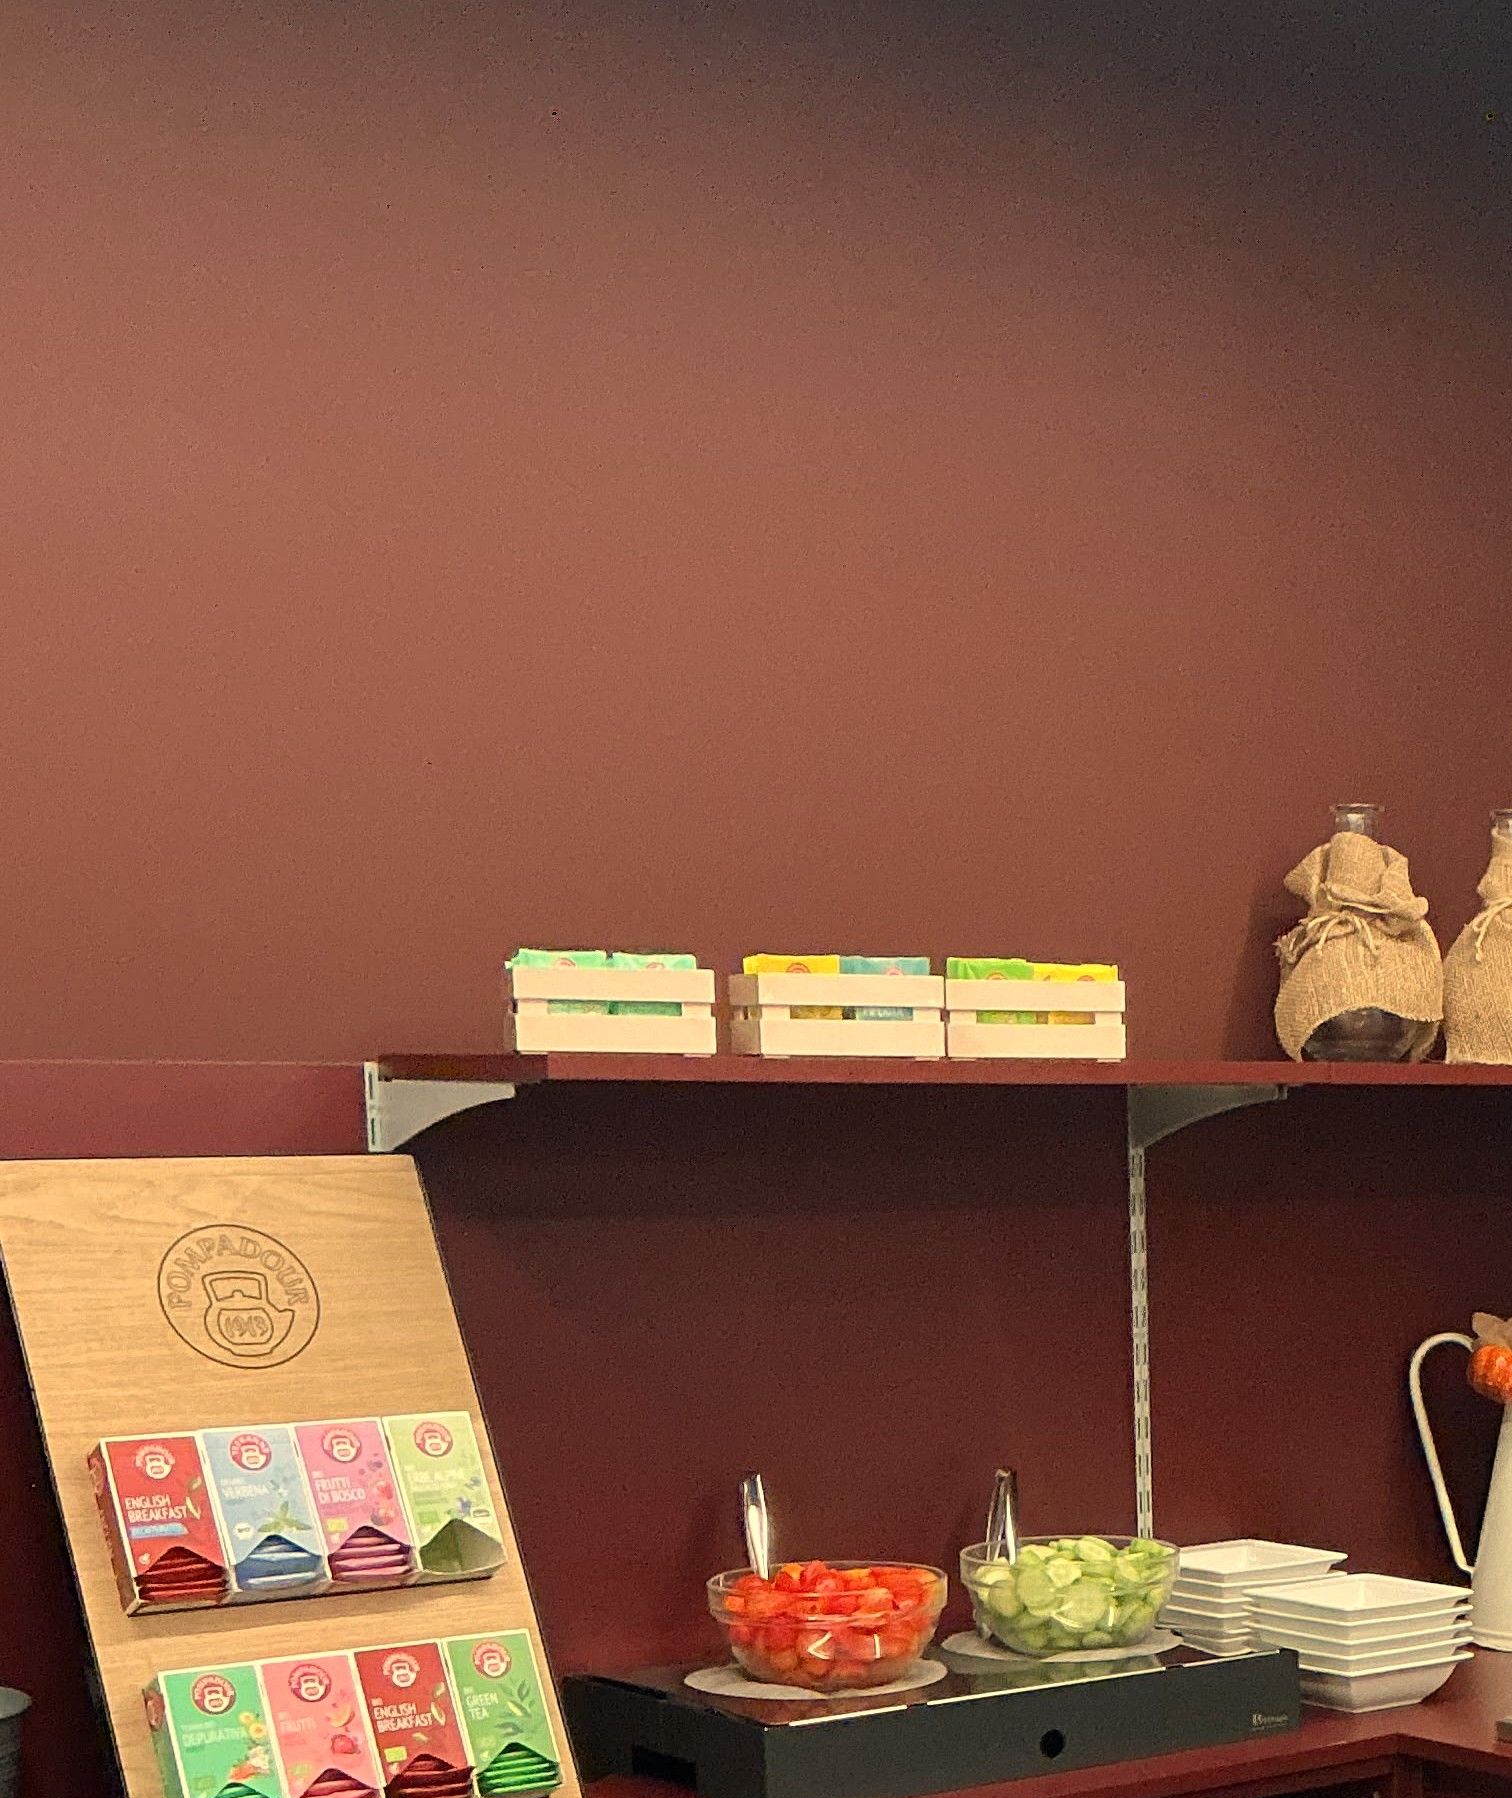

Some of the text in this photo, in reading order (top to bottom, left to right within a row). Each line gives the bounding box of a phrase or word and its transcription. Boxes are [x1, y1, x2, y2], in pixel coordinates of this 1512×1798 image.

[166, 1234, 309, 1309] POMPADOUR
[224, 1315, 269, 1338] 1913
[314, 1475, 351, 1491] FRUTTI
[124, 1494, 171, 1510] ENGLISH
[318, 1488, 366, 1505] DI BOSCO
[127, 1505, 187, 1523] BREAKFAST
[465, 1692, 499, 1708] GREEN
[373, 1702, 417, 1720] ENGLISH
[468, 1707, 490, 1720] TEA
[376, 1712, 433, 1733] BREAKFAST
